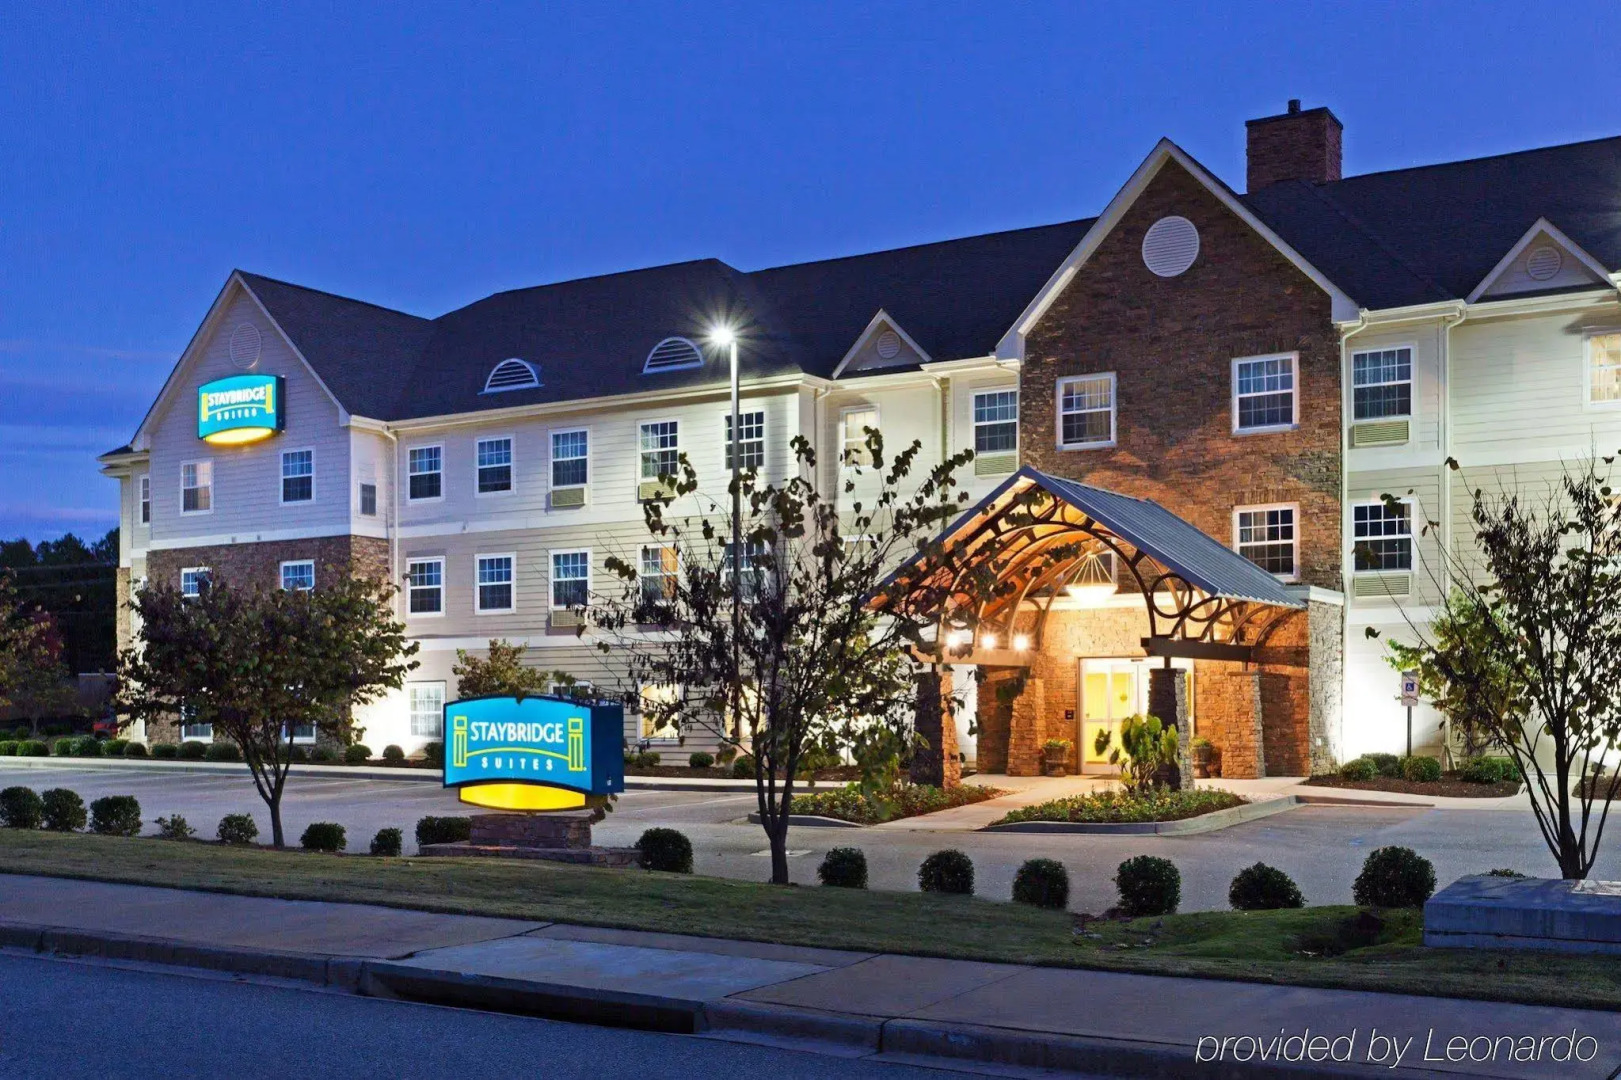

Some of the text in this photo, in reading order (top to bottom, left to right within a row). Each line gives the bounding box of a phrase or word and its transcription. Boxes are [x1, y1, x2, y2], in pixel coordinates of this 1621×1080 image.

[208, 386, 266, 406] STAYBRIDGE
[470, 721, 565, 743] STAYBRIDGE
[481, 757, 553, 771] SUITES
